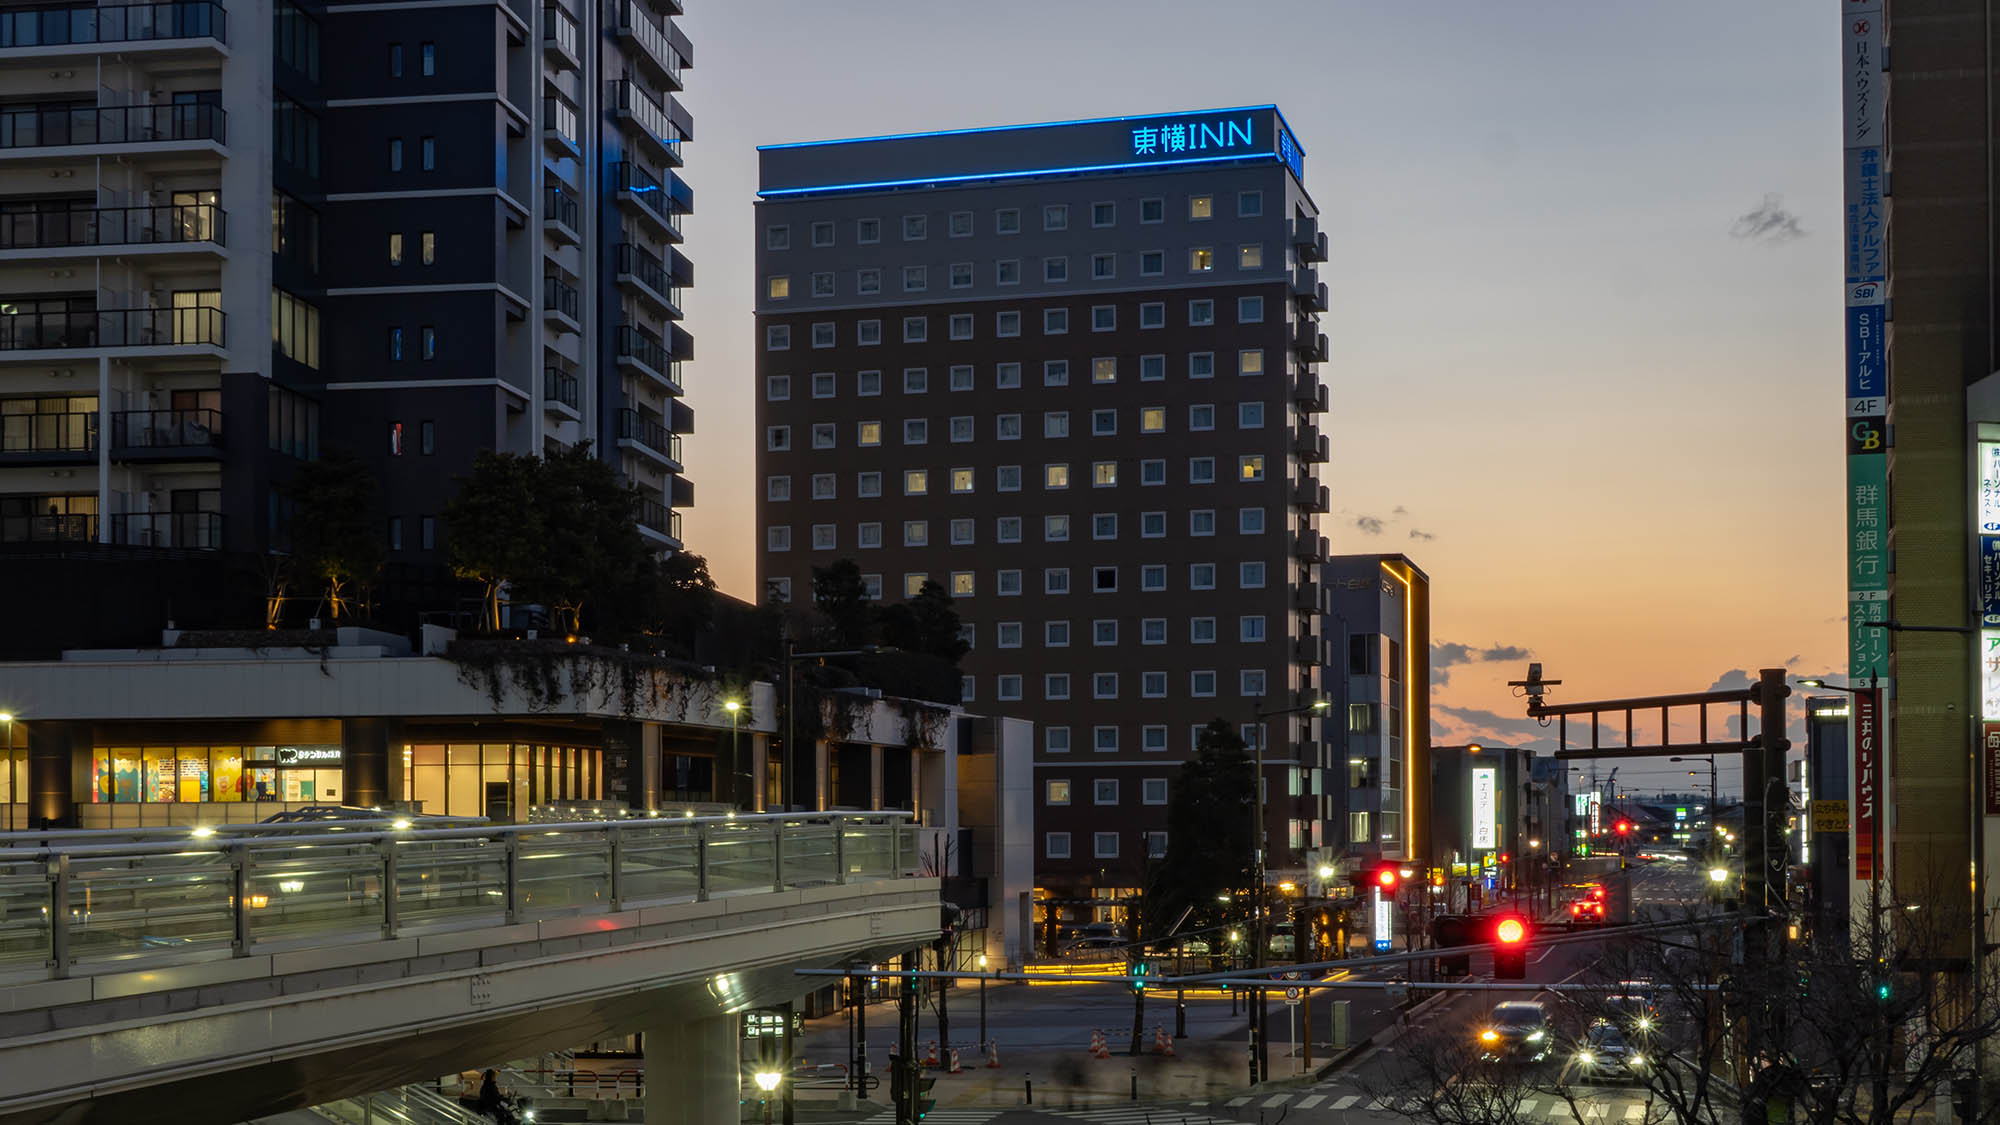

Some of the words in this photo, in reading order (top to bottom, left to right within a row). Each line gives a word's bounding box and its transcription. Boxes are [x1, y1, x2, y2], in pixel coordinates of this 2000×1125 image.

[1855, 41, 1872, 141] 日本ハウズイング
[1132, 117, 1252, 155] 東横INN
[1853, 288, 1875, 299] SBI
[1854, 400, 1878, 413] 4F
[1855, 484, 1879, 575] 群馬銀行
[1984, 554, 1992, 613] セキュリティ
[1854, 604, 1867, 676] ステーション
[1861, 703, 1873, 819] 三井のリハウス
